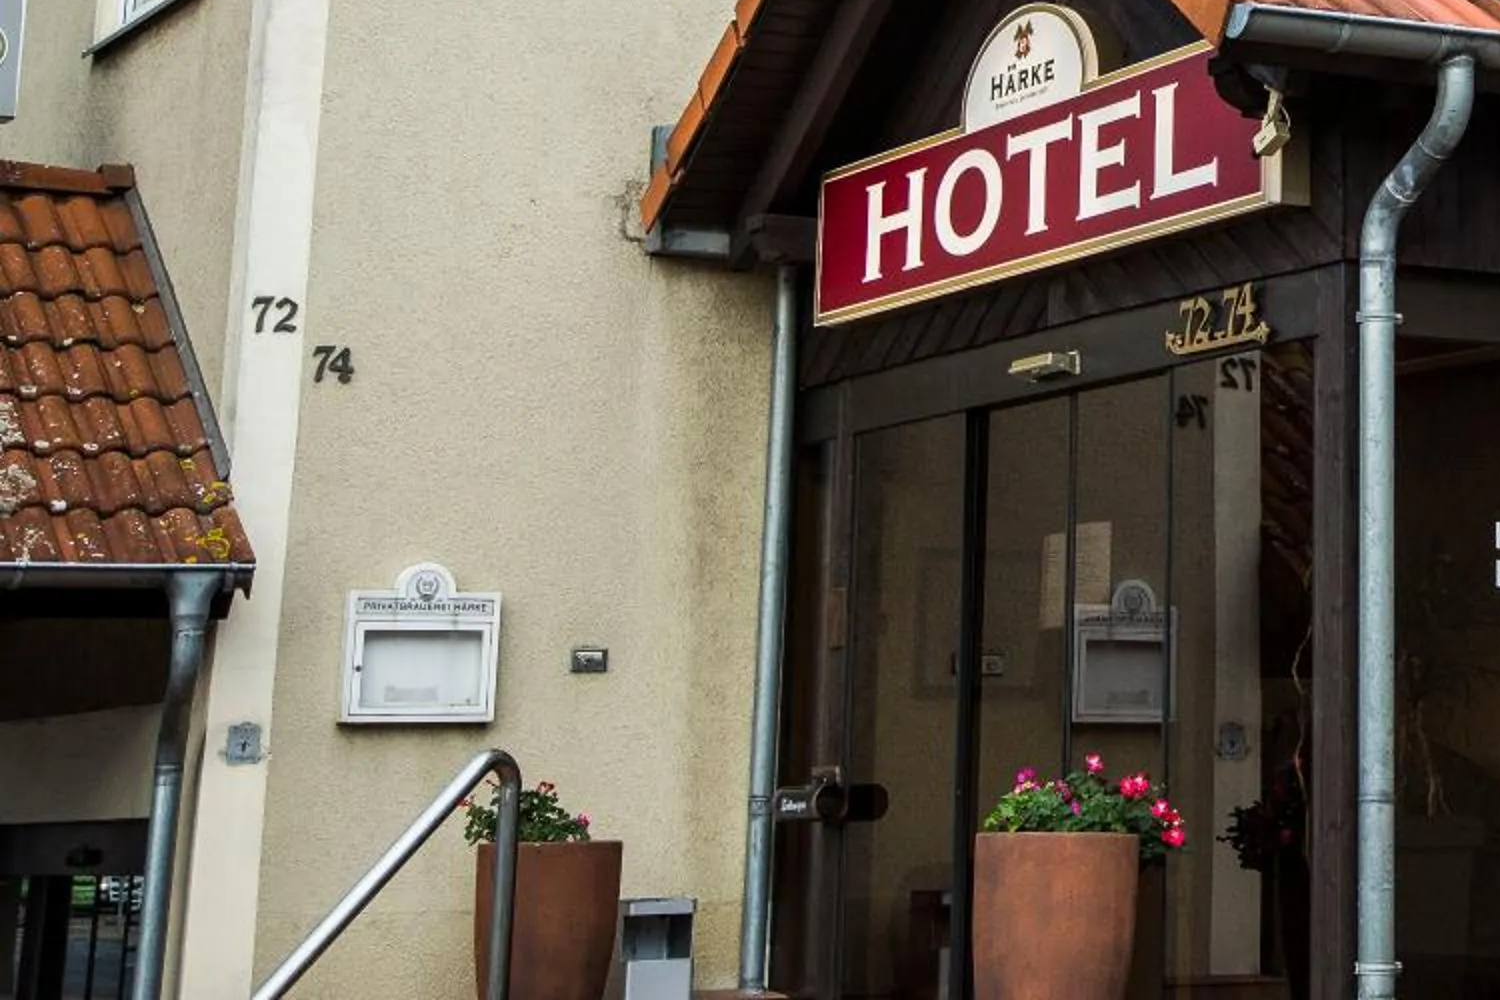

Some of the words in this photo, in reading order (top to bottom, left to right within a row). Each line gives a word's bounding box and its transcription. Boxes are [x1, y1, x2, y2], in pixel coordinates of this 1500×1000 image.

[990, 58, 1055, 101] HÄRKE
[861, 81, 1219, 284] HOTEL
[251, 295, 299, 334] 72
[312, 345, 355, 385] 74
